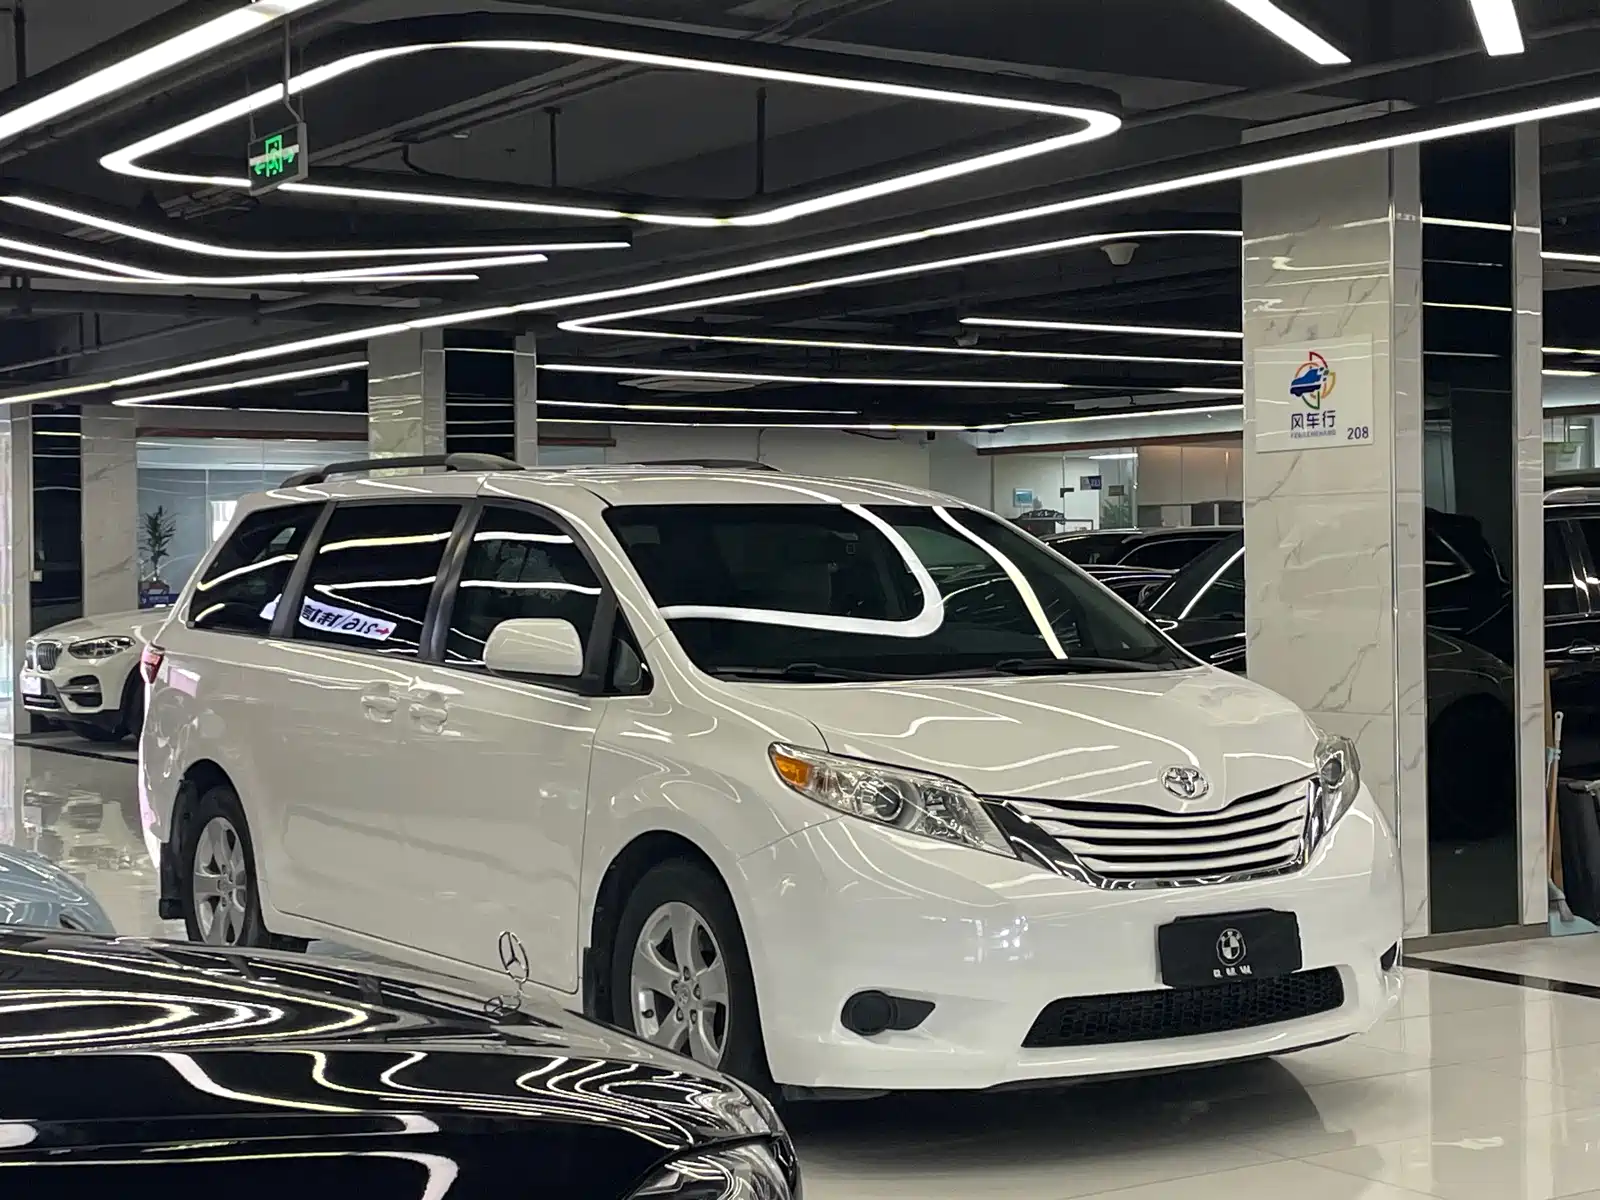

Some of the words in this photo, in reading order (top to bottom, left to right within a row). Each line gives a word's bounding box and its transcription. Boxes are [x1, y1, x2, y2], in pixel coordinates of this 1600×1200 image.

[1291, 410, 1336, 430] 风车行
[1347, 426, 1369, 440] 208
